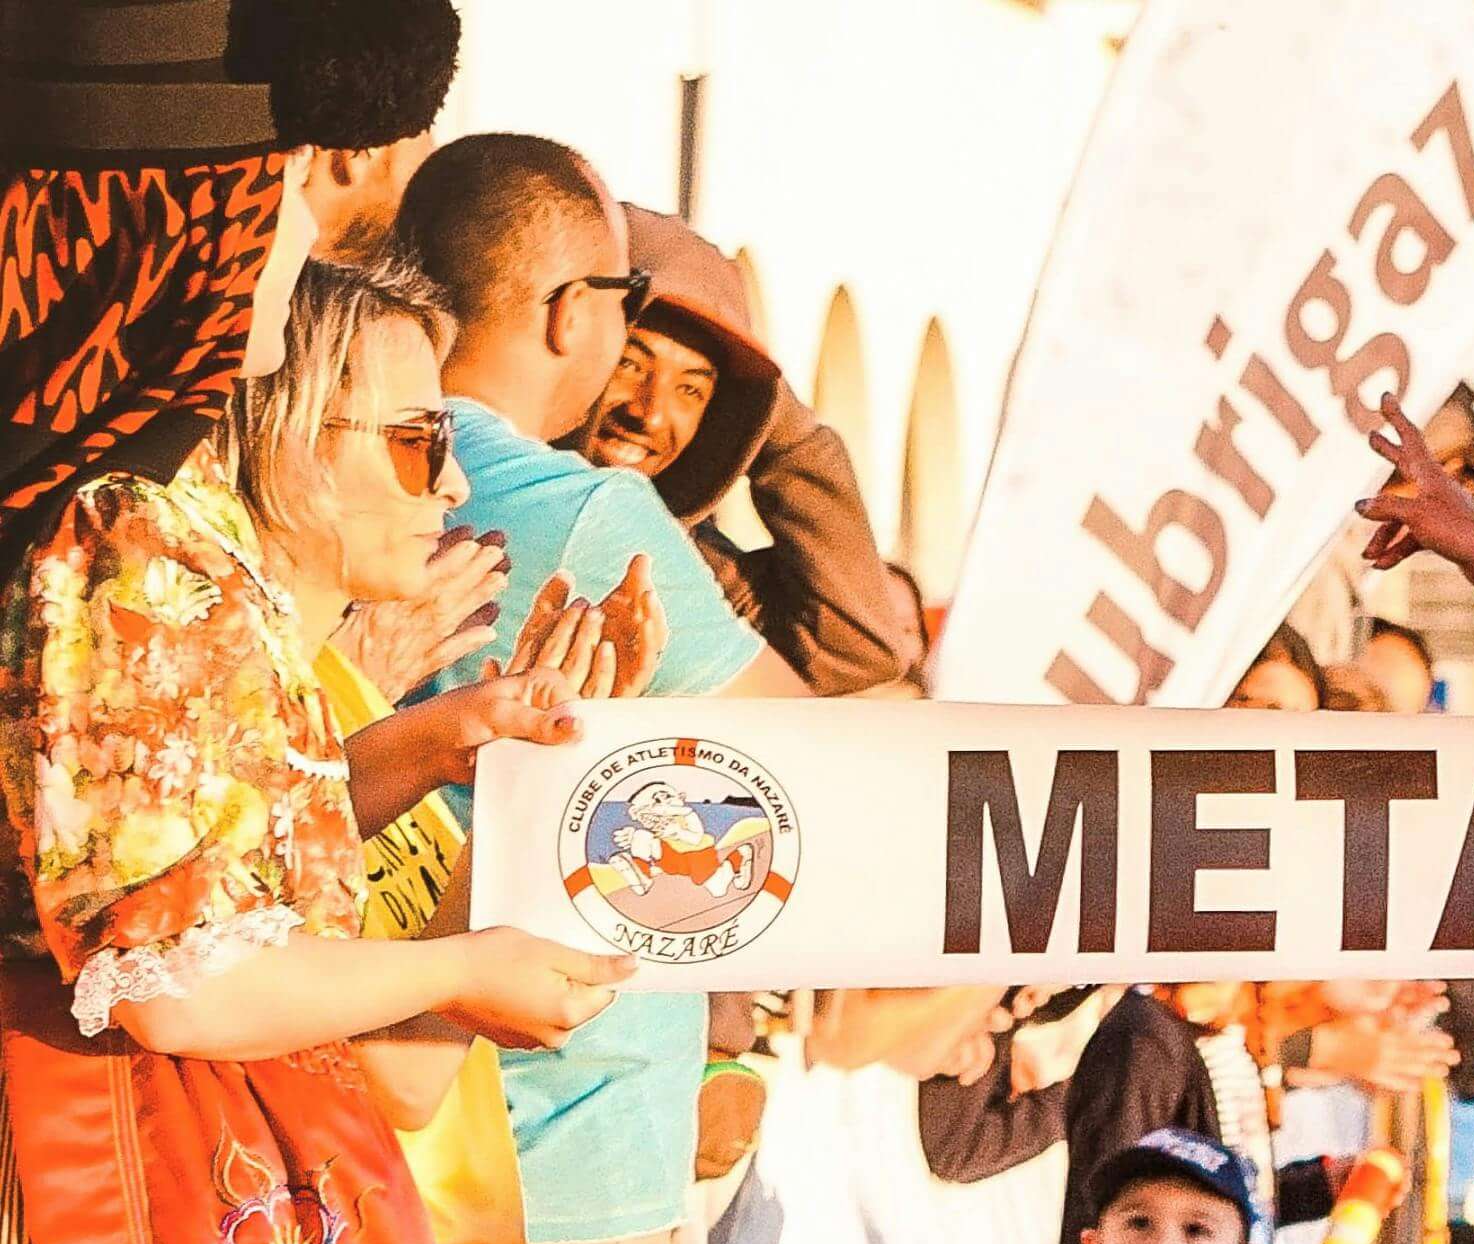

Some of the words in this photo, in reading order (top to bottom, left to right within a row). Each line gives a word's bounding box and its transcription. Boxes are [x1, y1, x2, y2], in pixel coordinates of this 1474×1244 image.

[569, 780, 601, 833] CLUBE
[601, 759, 623, 781] DE
[627, 746, 724, 767] ATLETISMO
[728, 759, 748, 777] DA
[751, 775, 794, 834] NAZARÉ
[613, 918, 740, 961] NAZARÉ
